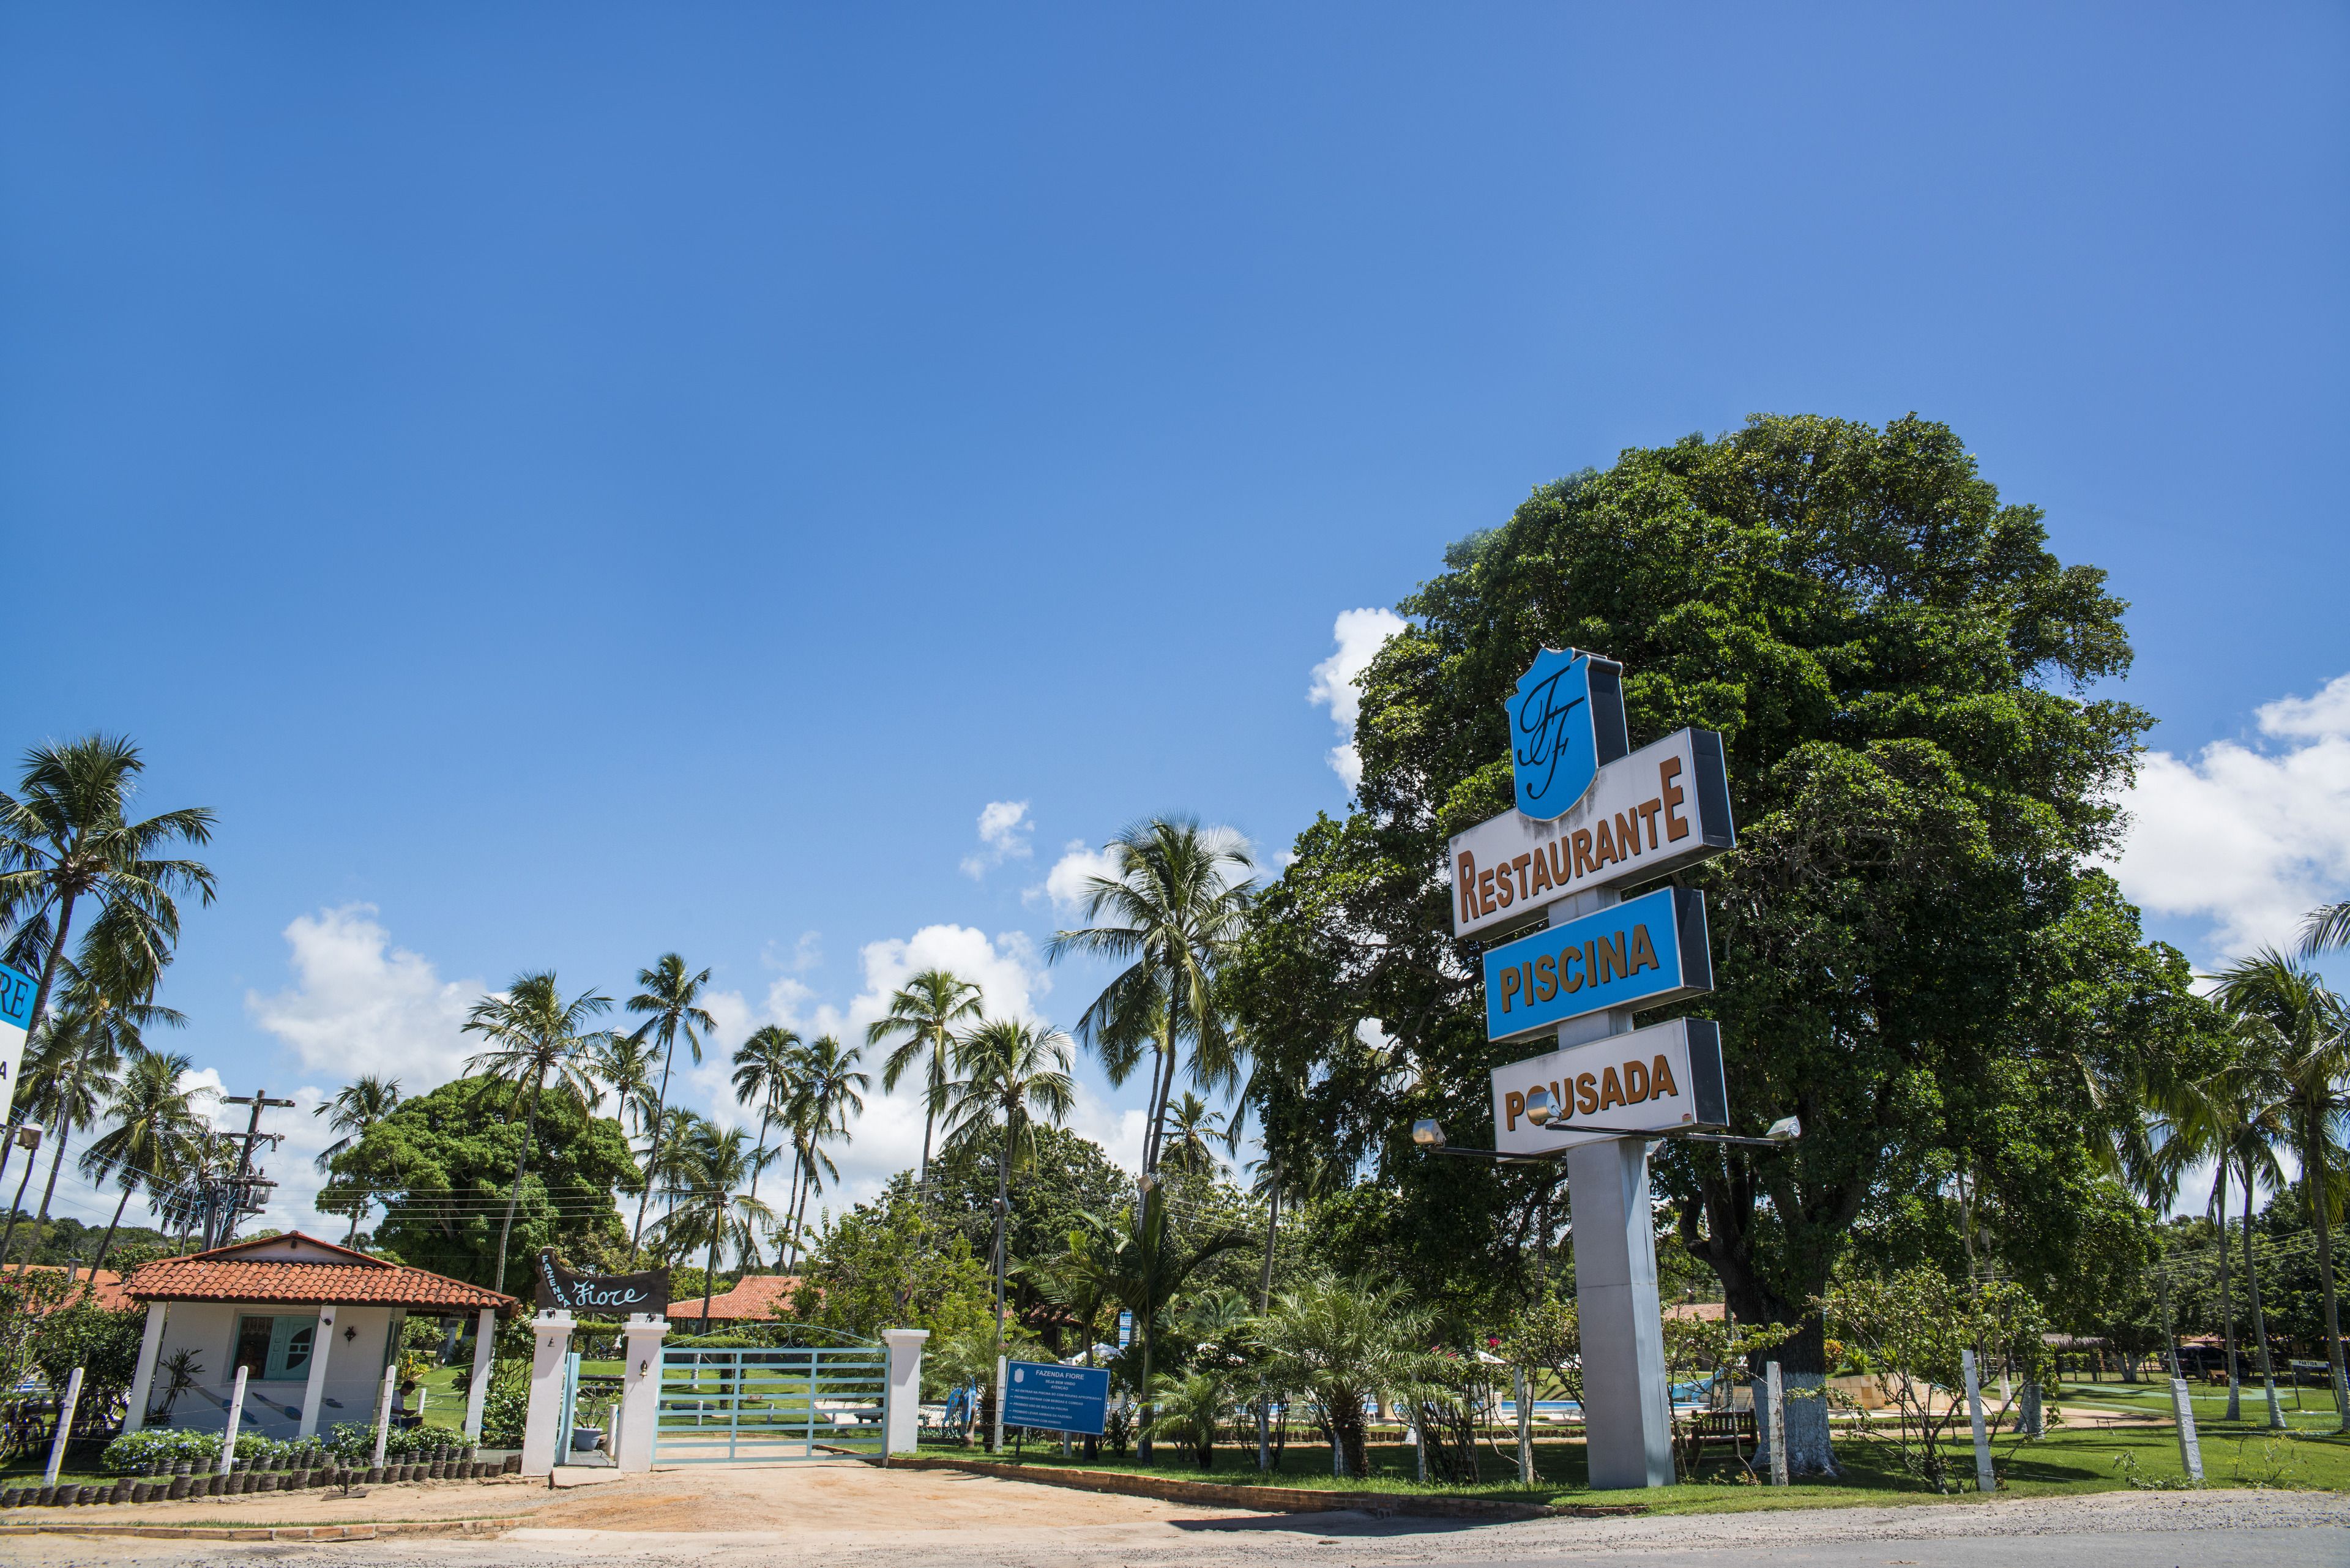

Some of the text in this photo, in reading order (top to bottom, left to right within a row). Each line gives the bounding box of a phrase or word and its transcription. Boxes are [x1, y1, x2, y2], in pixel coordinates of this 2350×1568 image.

[1500, 924, 1660, 1014] PISCINA
[542, 1255, 571, 1308] FAZENDA
[572, 1280, 648, 1306] Fiore
[1035, 1369, 1064, 1378] FAZENDA
